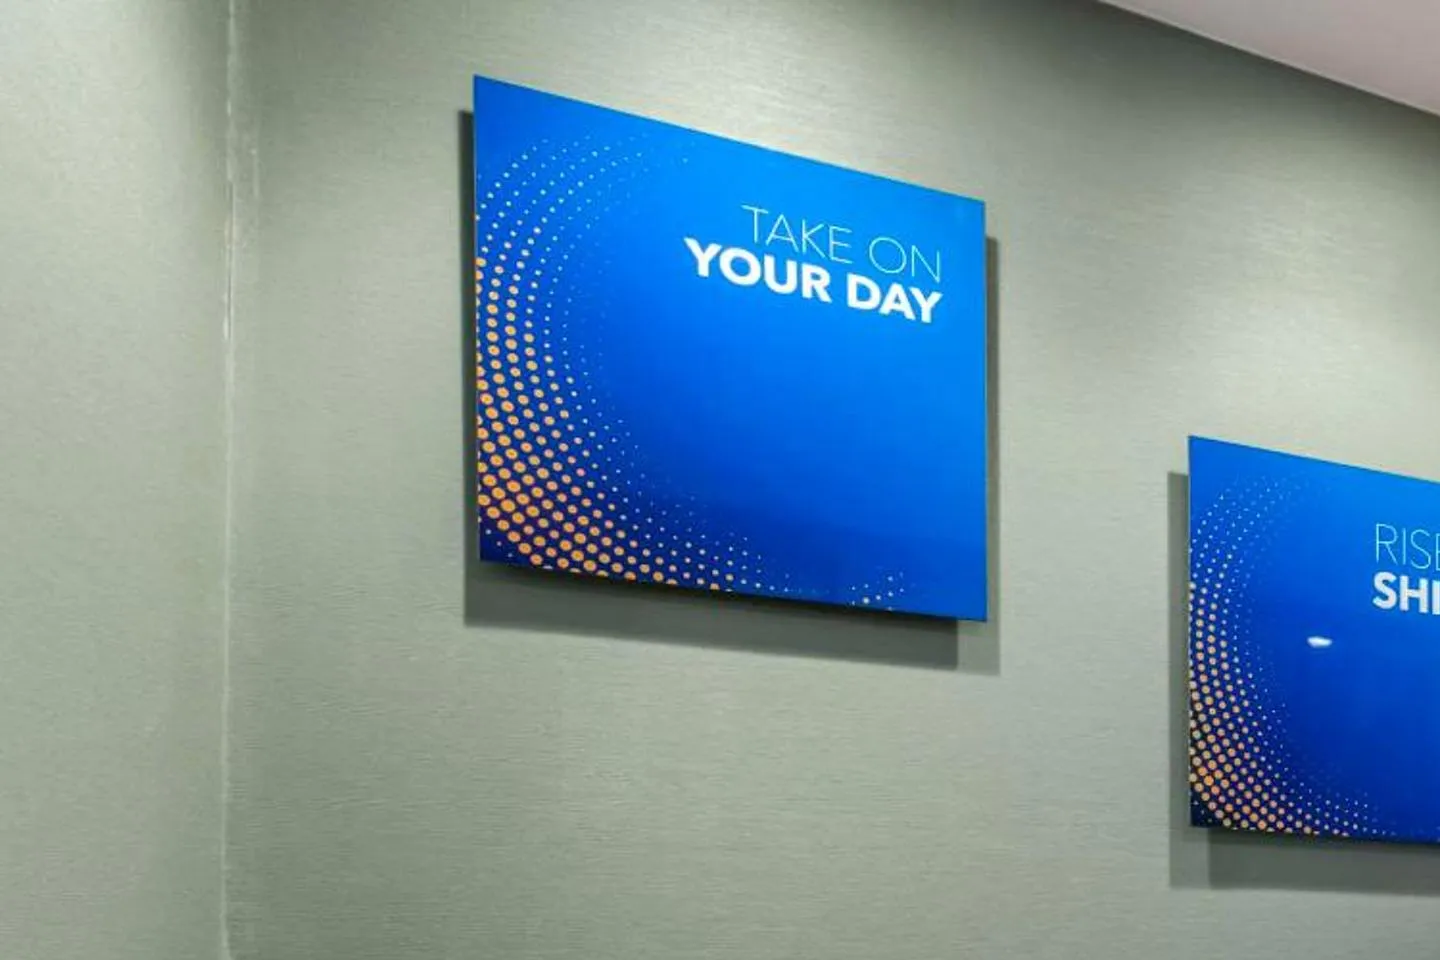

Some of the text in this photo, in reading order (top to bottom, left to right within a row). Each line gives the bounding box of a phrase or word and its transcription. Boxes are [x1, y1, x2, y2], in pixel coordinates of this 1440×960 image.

[683, 236, 944, 324] YOUR DAY
[741, 204, 941, 284] TAKE ON
